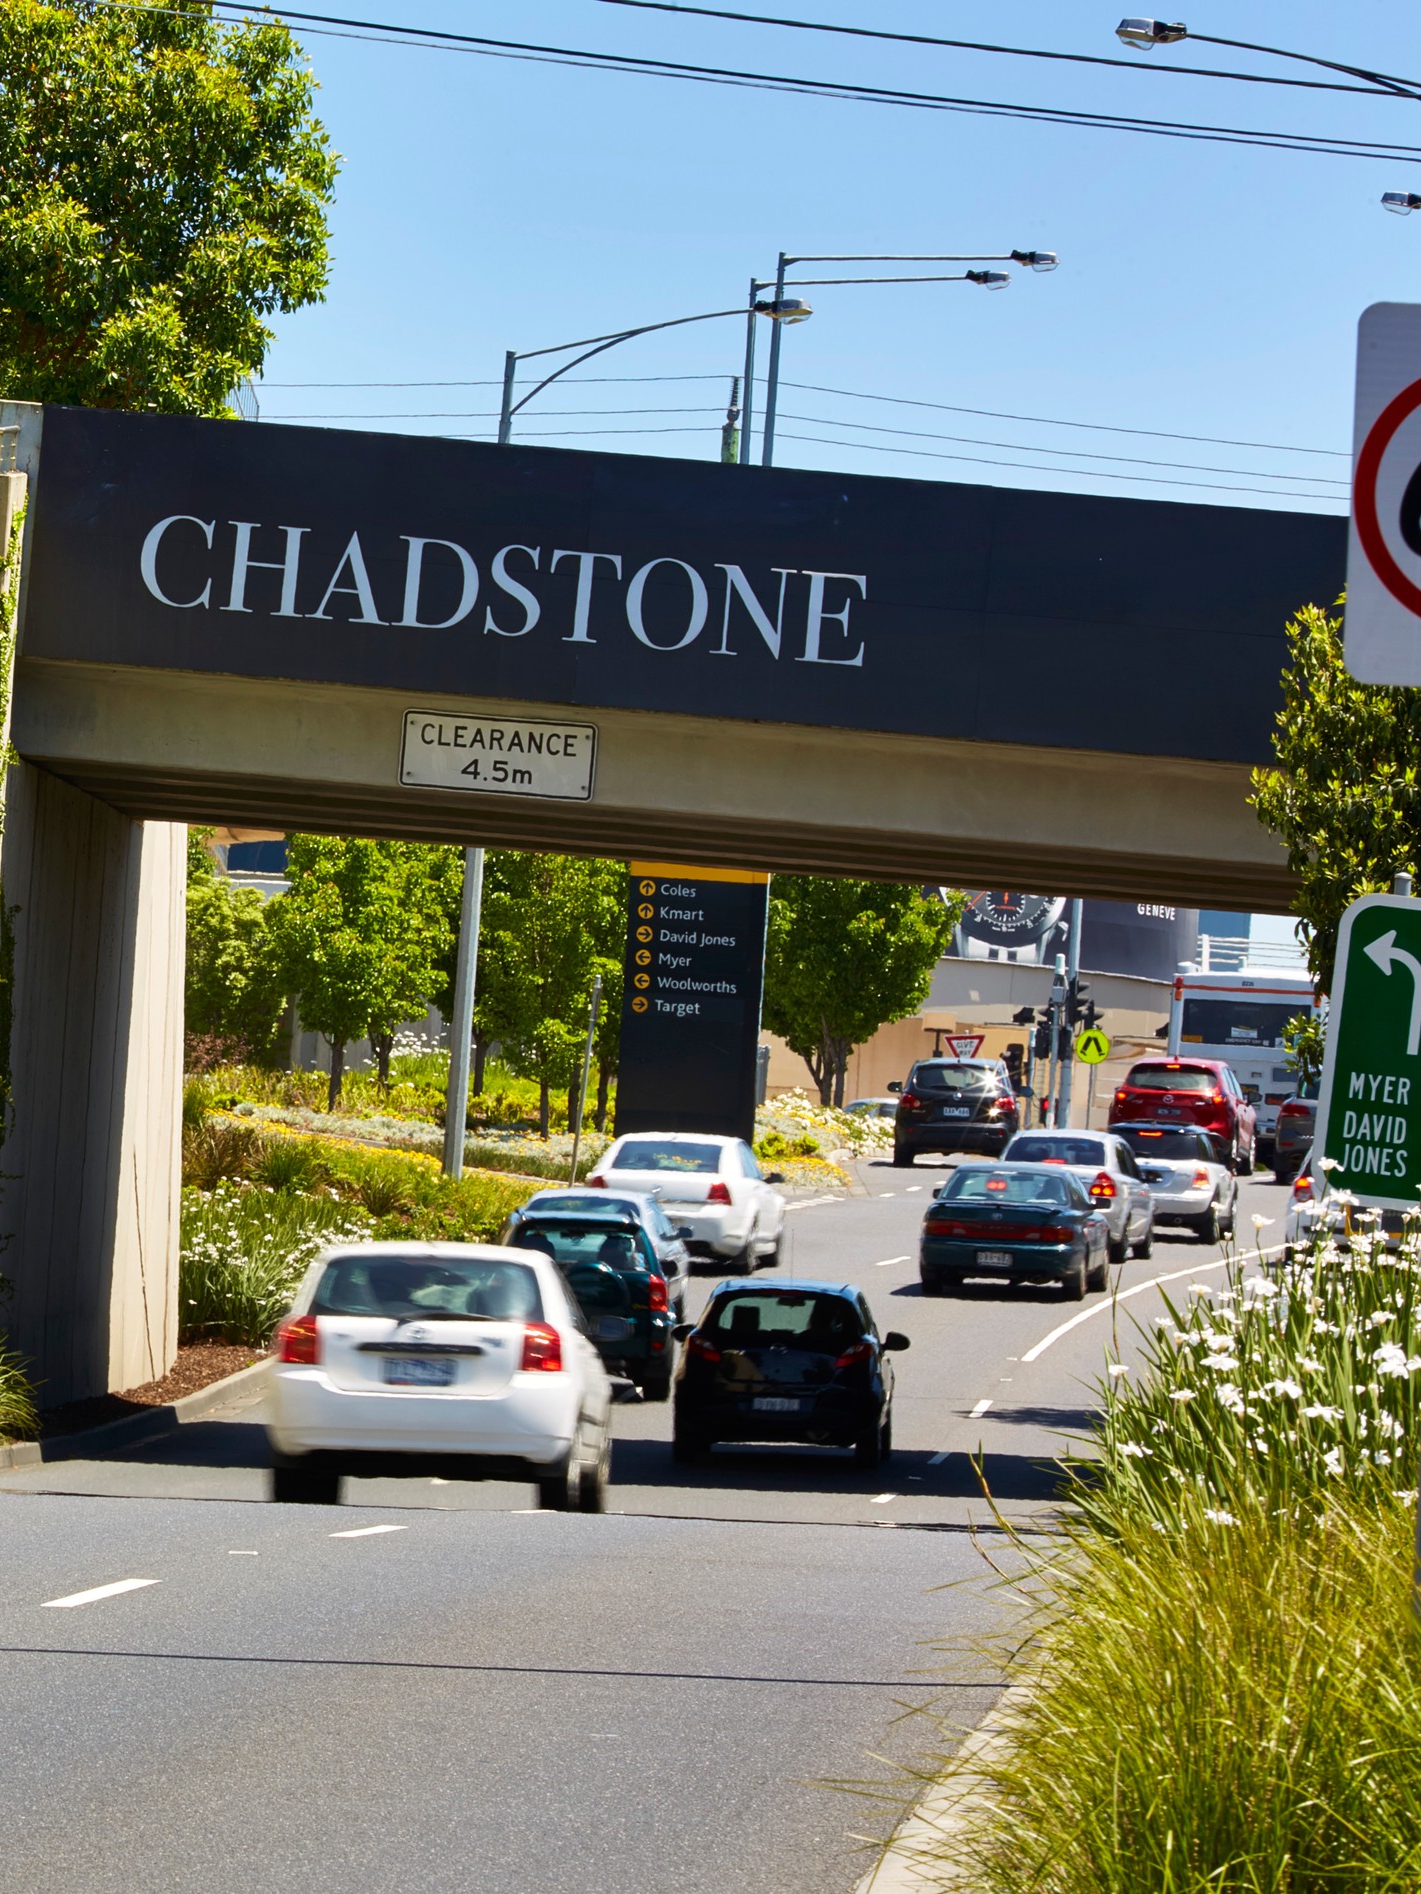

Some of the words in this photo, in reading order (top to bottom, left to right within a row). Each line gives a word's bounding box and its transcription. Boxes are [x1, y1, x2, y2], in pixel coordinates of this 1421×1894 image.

[140, 514, 867, 667] CHADSTONE
[420, 723, 578, 757] CLEARANCE
[460, 758, 533, 785] 4.5m
[660, 883, 697, 898] Coles
[660, 906, 705, 921] Kmart
[1137, 903, 1176, 921] GENEVE
[660, 929, 697, 944] David
[699, 933, 736, 947] Jones
[658, 952, 692, 969] Myer
[657, 976, 737, 994] Woolworths
[655, 999, 700, 1017] Target
[956, 1040, 975, 1049] GIVE
[1348, 1071, 1411, 1105] MYER
[1342, 1110, 1407, 1145] DAVID
[1342, 1143, 1408, 1178] JONES
